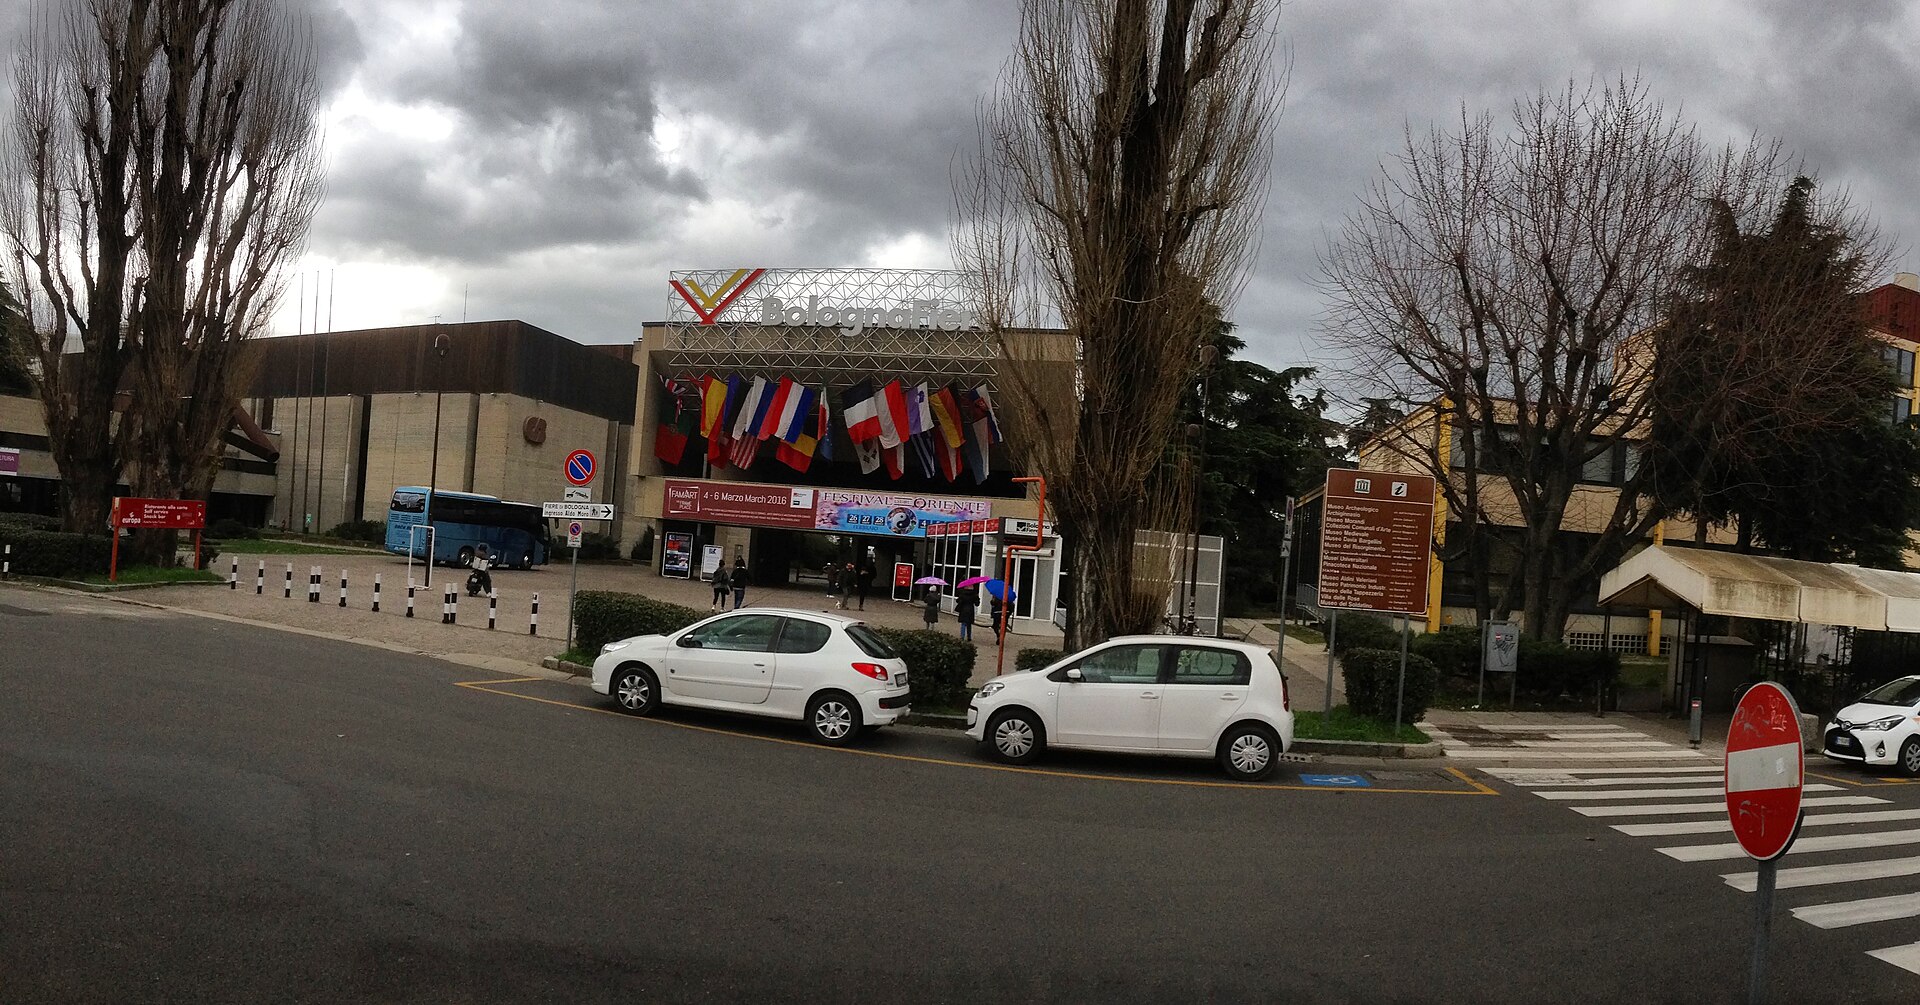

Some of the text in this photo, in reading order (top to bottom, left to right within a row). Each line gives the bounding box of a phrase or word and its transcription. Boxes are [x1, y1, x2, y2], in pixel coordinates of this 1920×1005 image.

[762, 296, 998, 336] BolognaFier
[672, 490, 698, 499] FAMART
[722, 493, 744, 502] Marzo
[745, 494, 766, 503] March
[768, 496, 787, 504] 2016
[824, 492, 893, 506] FESTIVAL
[914, 498, 985, 512] ORIENTE
